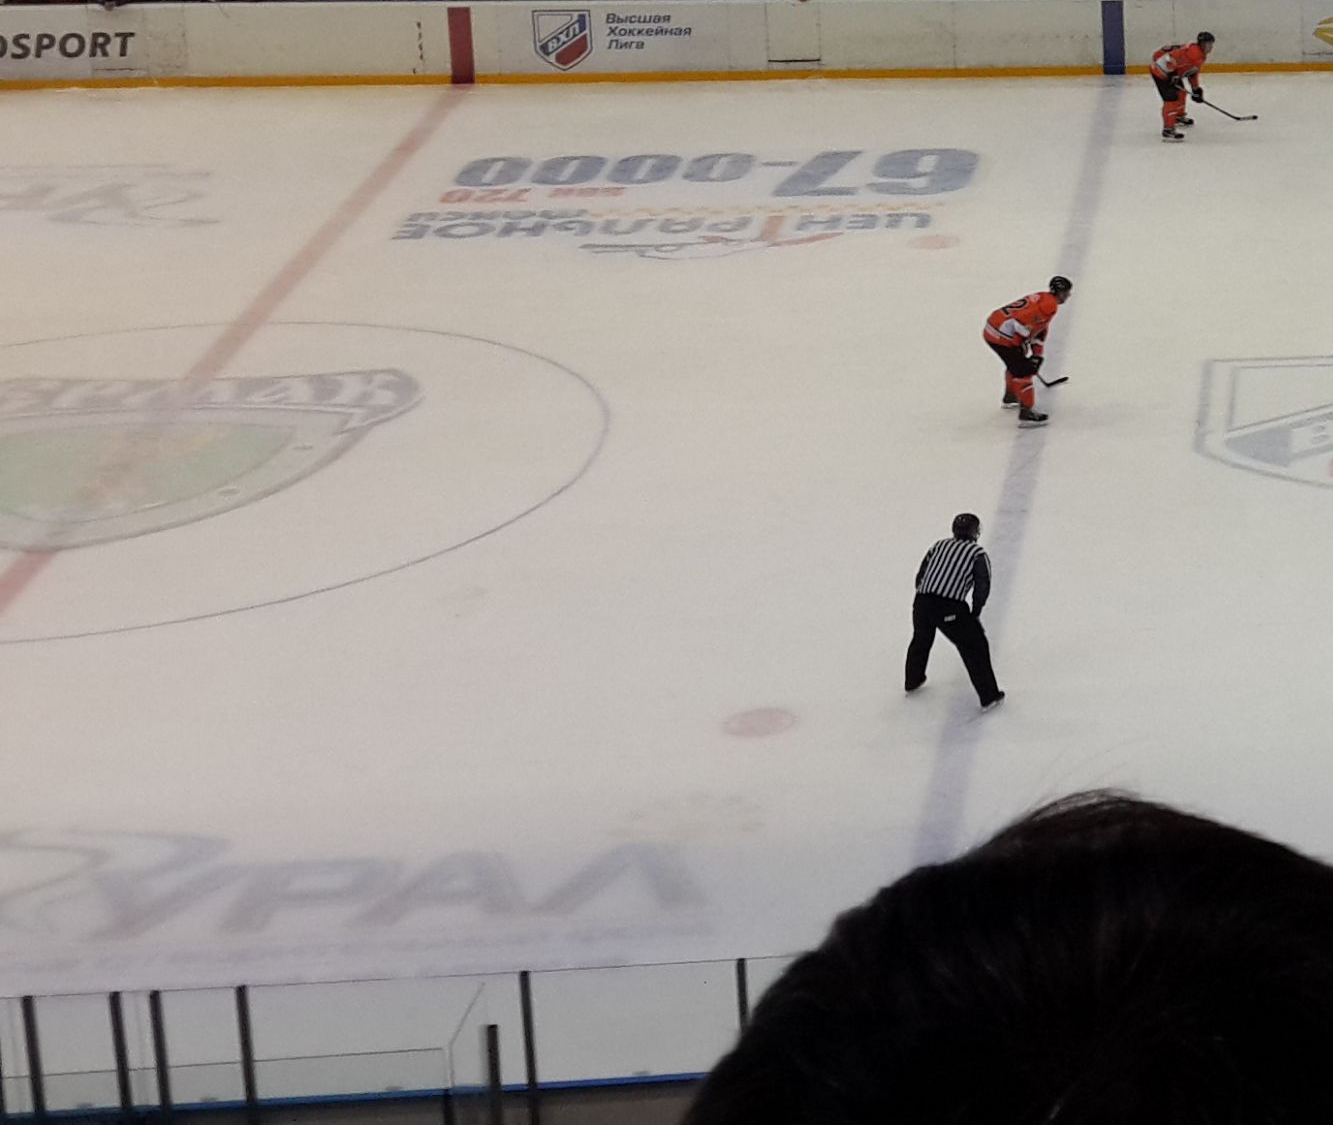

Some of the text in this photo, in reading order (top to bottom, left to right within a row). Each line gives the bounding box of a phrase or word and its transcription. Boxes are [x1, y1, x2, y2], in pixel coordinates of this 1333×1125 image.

[606, 13, 671, 24] Высшая
[606, 26, 692, 38] Хоккейная
[0, 32, 136, 60] SPORT
[547, 25, 581, 52] ВХЛ
[607, 39, 644, 50] Лига
[453, 148, 981, 197] 67-0000
[390, 213, 932, 243] ЦЕНТРАЛЬНОЕ
